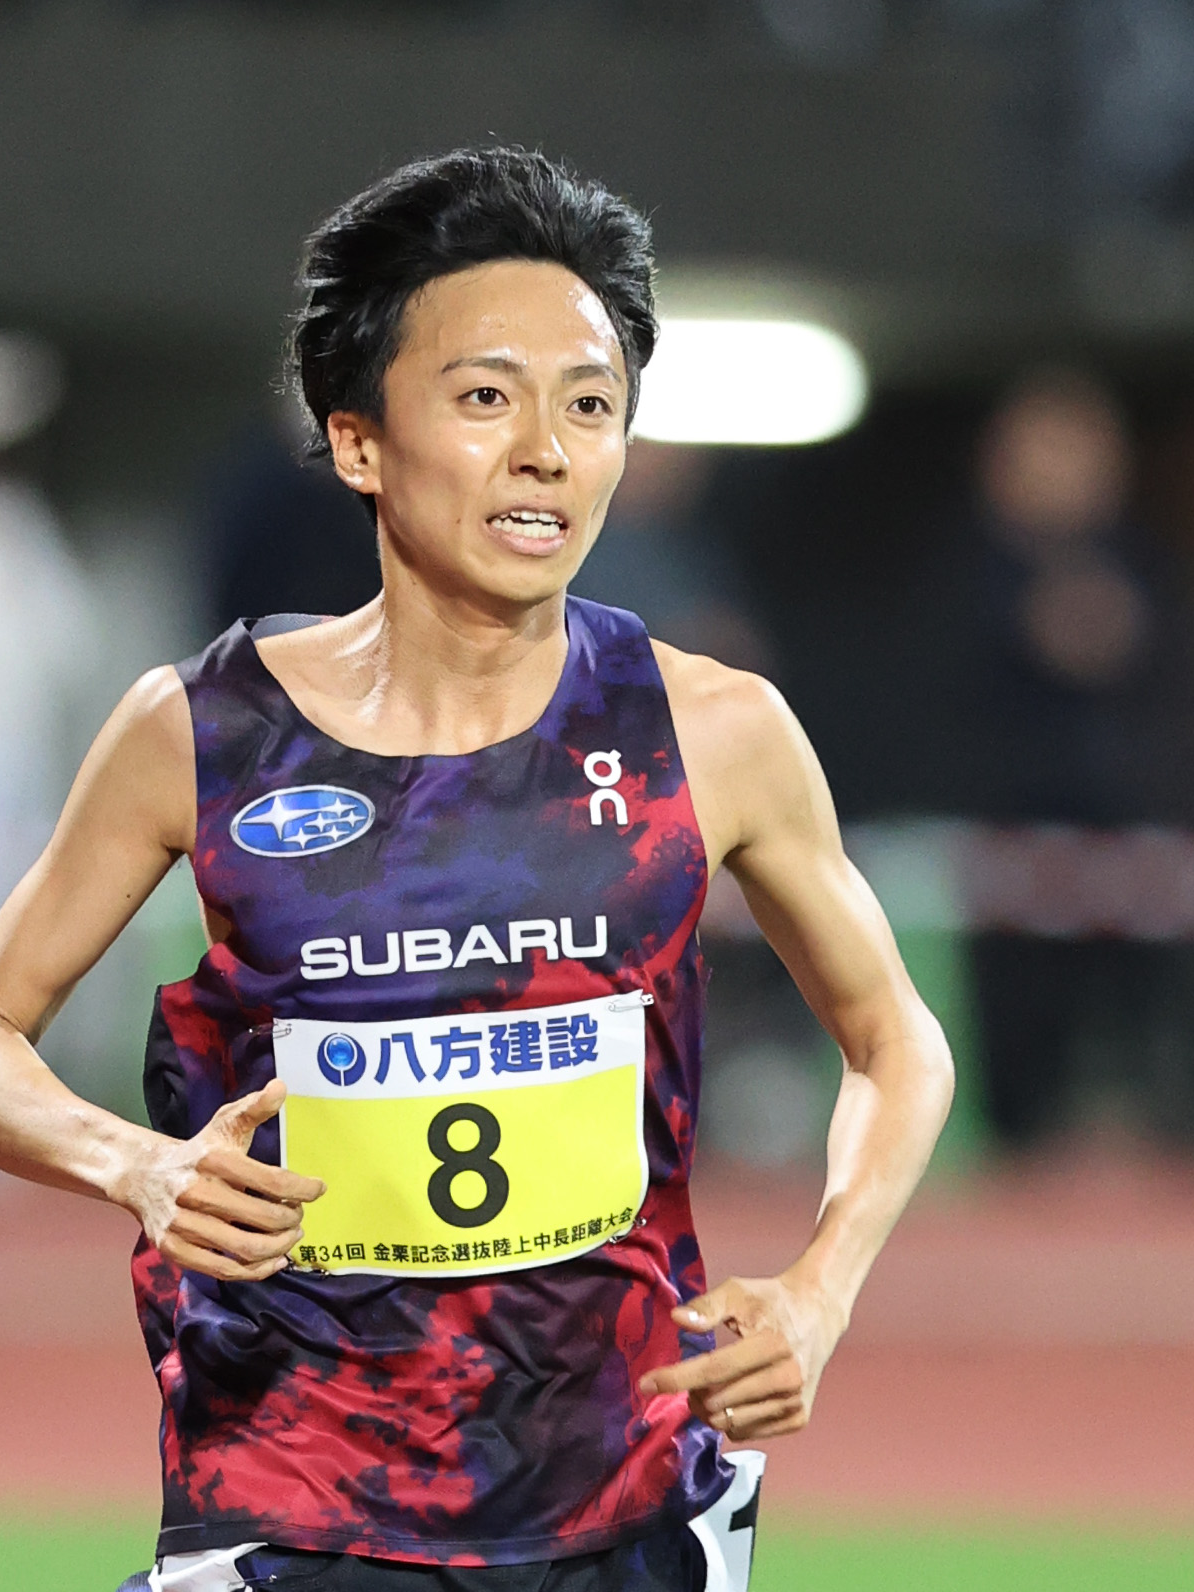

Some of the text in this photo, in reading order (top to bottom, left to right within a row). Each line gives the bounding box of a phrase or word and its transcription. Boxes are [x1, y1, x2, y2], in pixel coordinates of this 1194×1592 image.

[300, 915, 606, 980] SUBARU
[374, 1016, 599, 1084] 八方建設
[427, 1102, 509, 1228] 8
